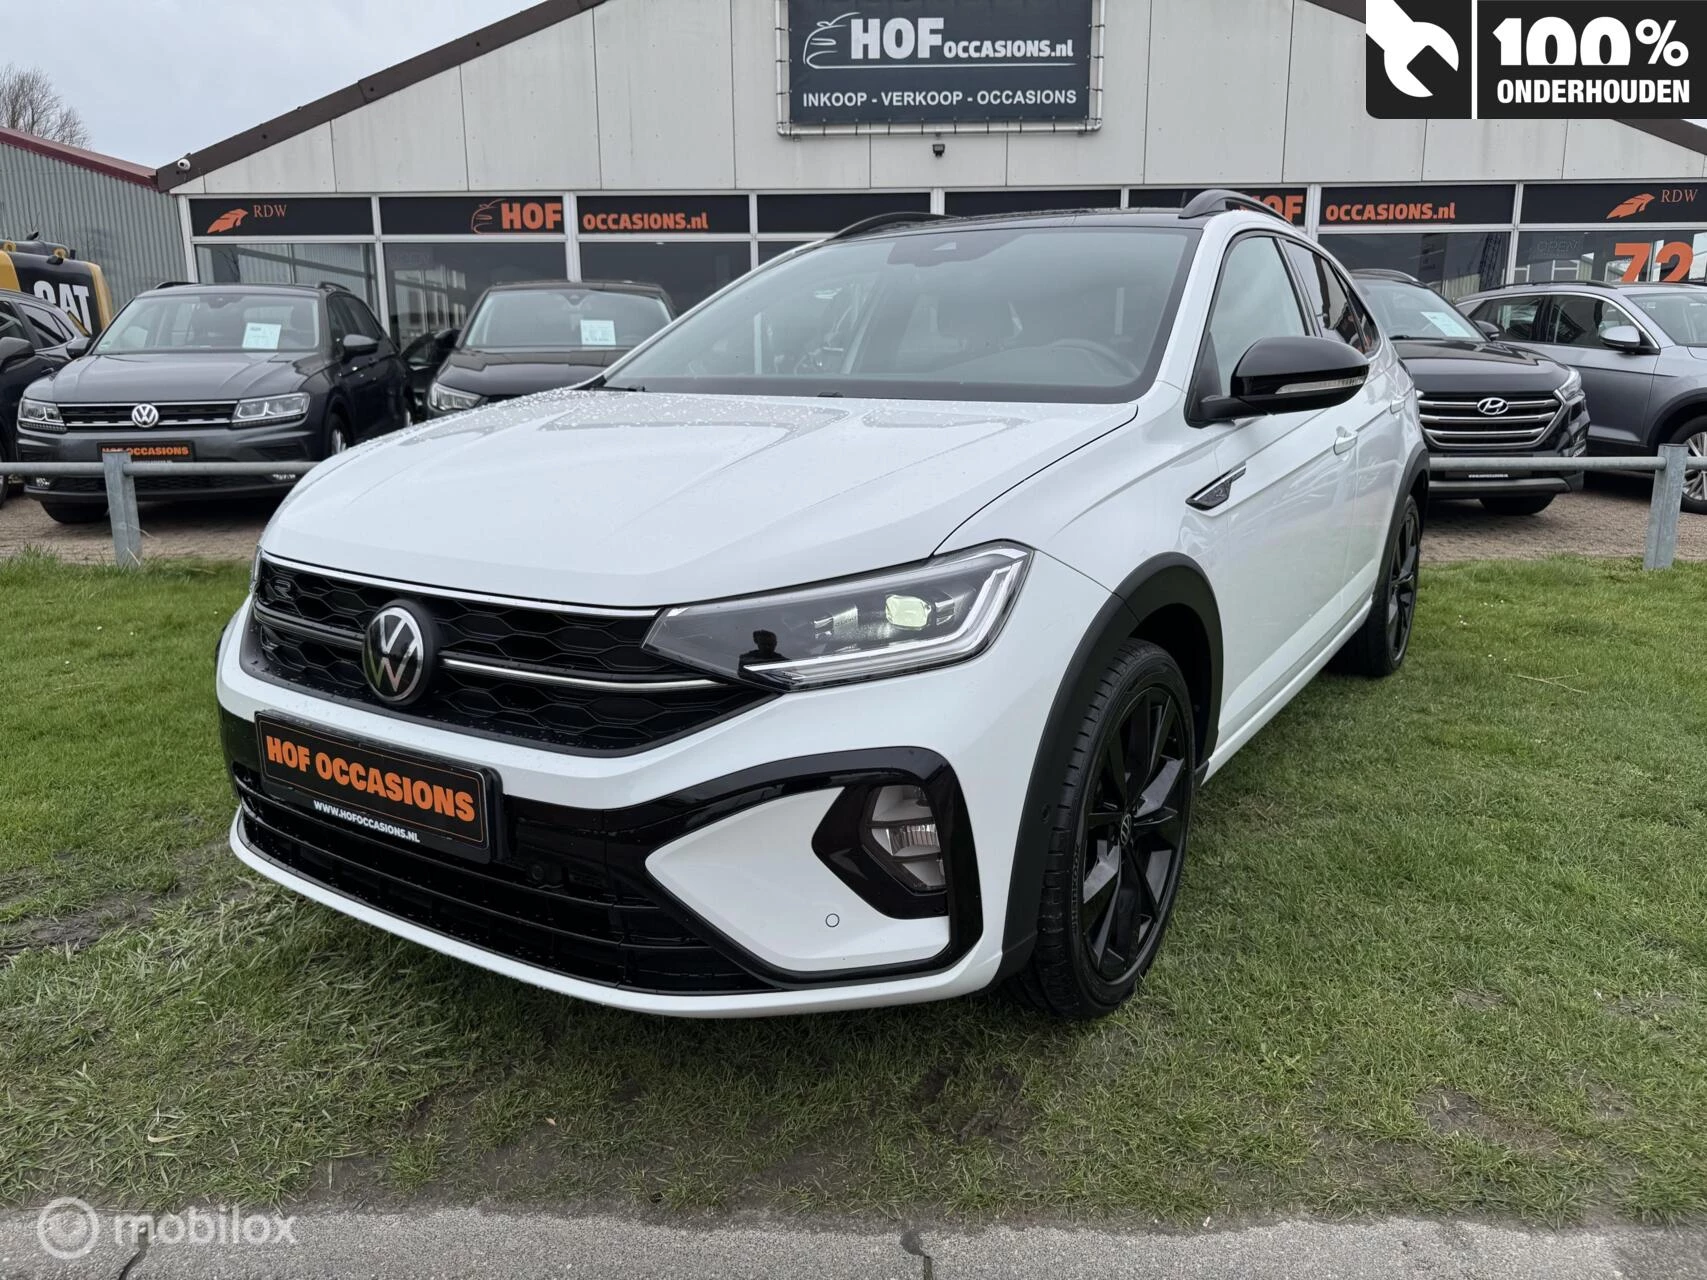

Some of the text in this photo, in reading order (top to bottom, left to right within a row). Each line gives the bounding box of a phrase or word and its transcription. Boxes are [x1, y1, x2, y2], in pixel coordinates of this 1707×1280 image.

[850, 17, 1074, 60] HOF OCCASIONS.nl
[803, 92, 867, 108] INKOOP
[881, 91, 963, 107] VERKOOP
[976, 90, 1077, 105] OCCASIONS
[1240, 194, 1456, 223] OF OCCASIONS.nl
[1660, 188, 1698, 204] RDW
[253, 204, 288, 218] RDW
[501, 202, 709, 231] HOF OCCASIONS.nl
[266, 735, 476, 823] HOF OCCASIONS
[313, 800, 420, 844] WWW.HOFOCCASIONS.NL
